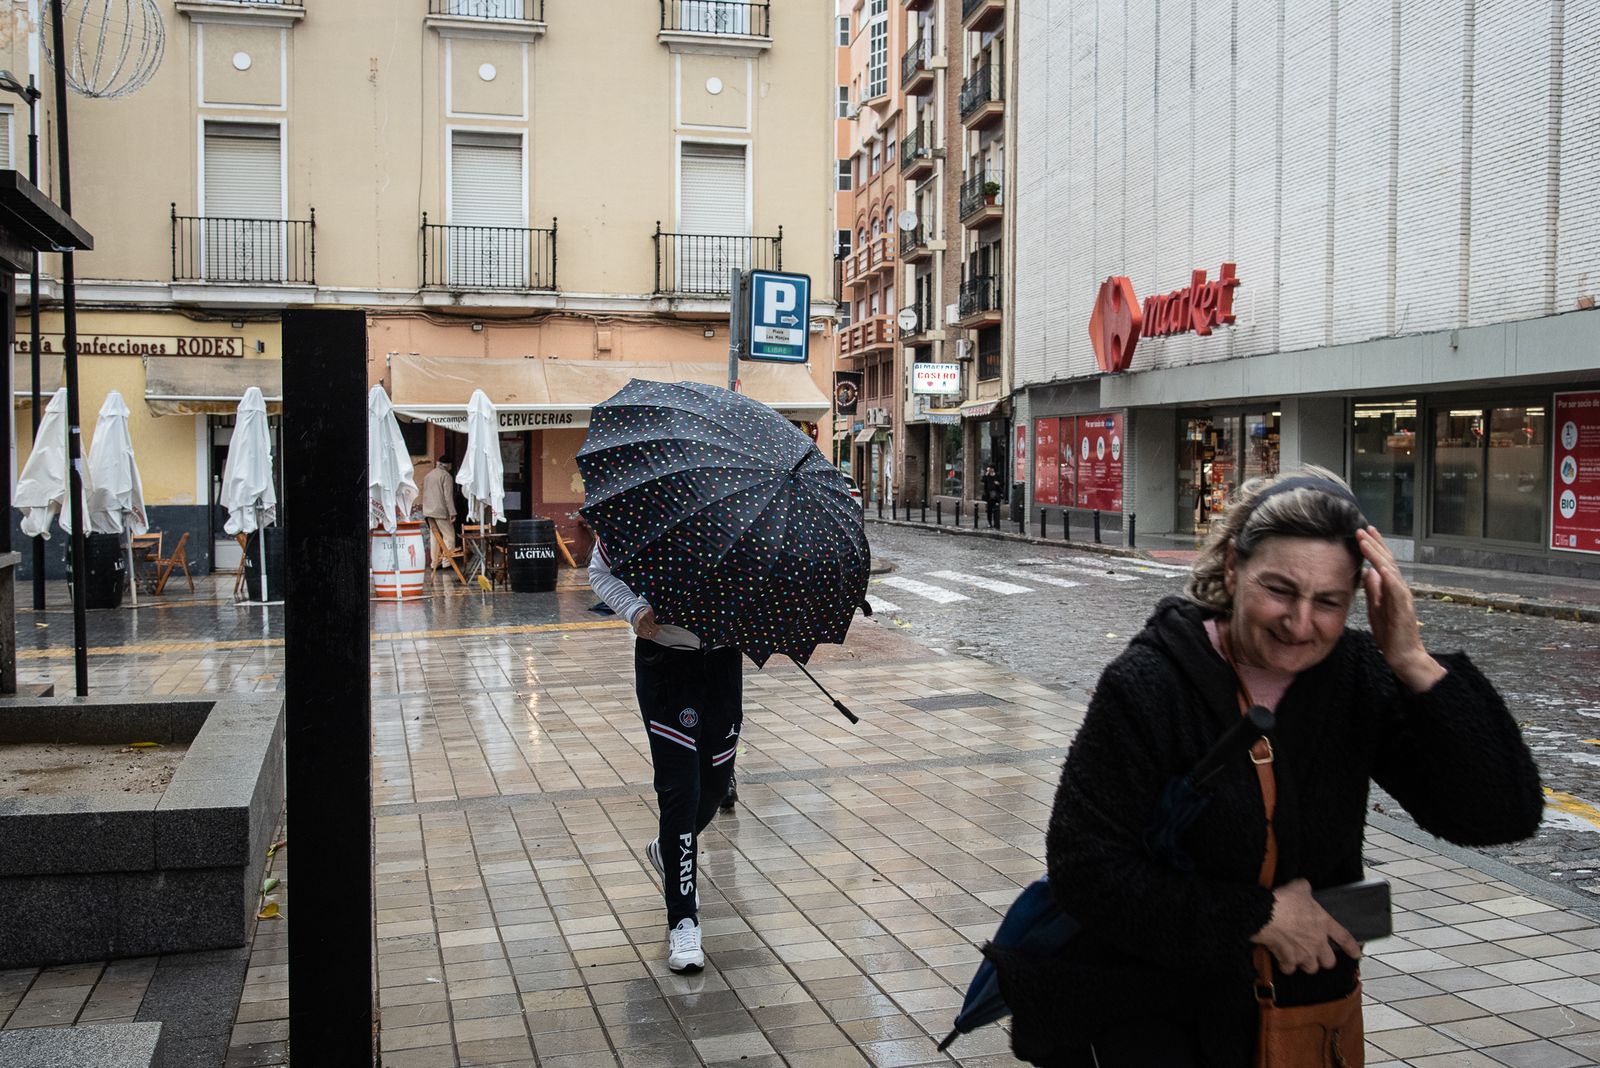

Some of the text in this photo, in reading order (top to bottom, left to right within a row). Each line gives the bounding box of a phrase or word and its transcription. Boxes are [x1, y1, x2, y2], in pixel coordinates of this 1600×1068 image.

[763, 281, 797, 324] P
[1141, 263, 1241, 337] market
[177, 338, 235, 356] RODES
[917, 372, 957, 380] CASTRO
[426, 416, 468, 424] Cruzcampo
[500, 412, 573, 427] CERVECERIAS
[1561, 498, 1575, 510] BIO
[515, 550, 555, 560] LA GITANA
[680, 832, 694, 896] PARIS
